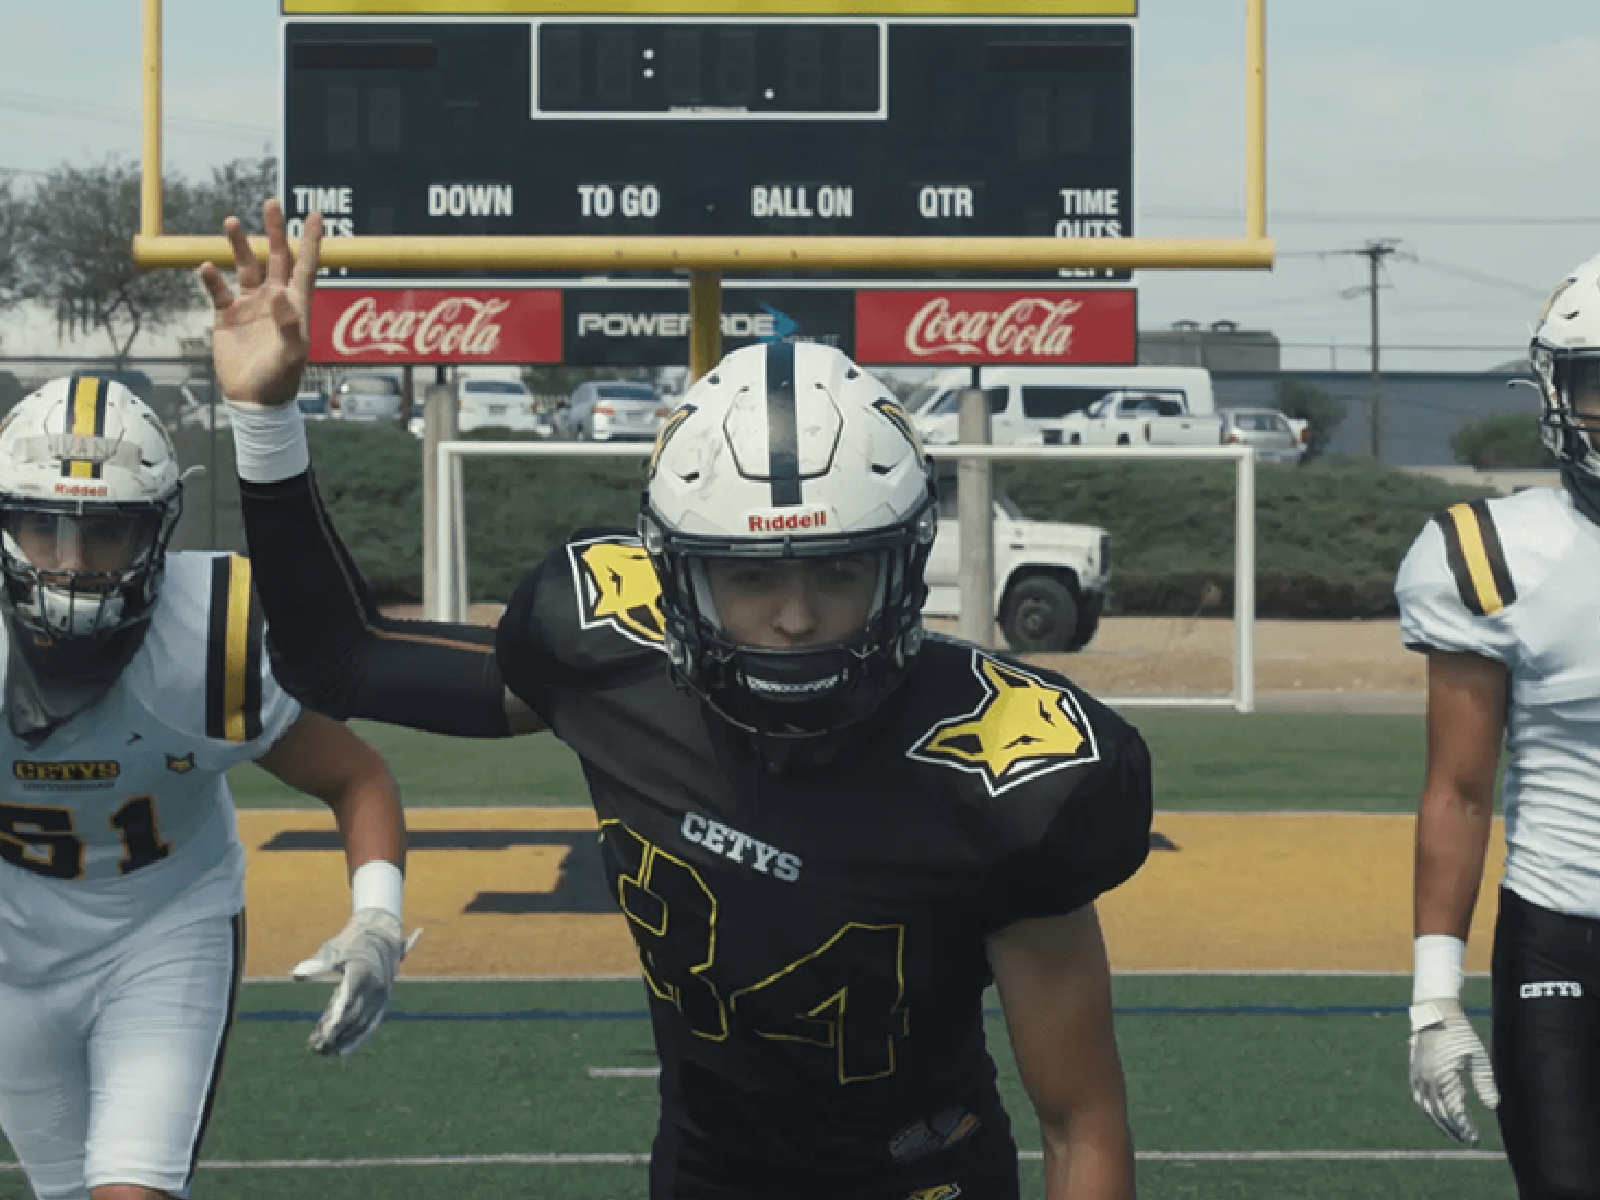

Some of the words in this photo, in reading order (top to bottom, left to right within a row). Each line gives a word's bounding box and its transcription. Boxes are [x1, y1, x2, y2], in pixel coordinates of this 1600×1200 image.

[293, 186, 353, 215] TIME
[428, 184, 513, 217] DOWN
[577, 184, 612, 217] TO
[620, 185, 661, 217] GO
[751, 185, 813, 218] BALL
[816, 186, 853, 218] ON
[918, 186, 974, 219] QTR
[1059, 187, 1119, 215] TIME
[287, 217, 354, 238] OTS
[748, 508, 828, 533] Riddell
[13, 760, 120, 780] CETYS
[680, 811, 803, 883] CETYS
[1519, 980, 1584, 999] CETYS
